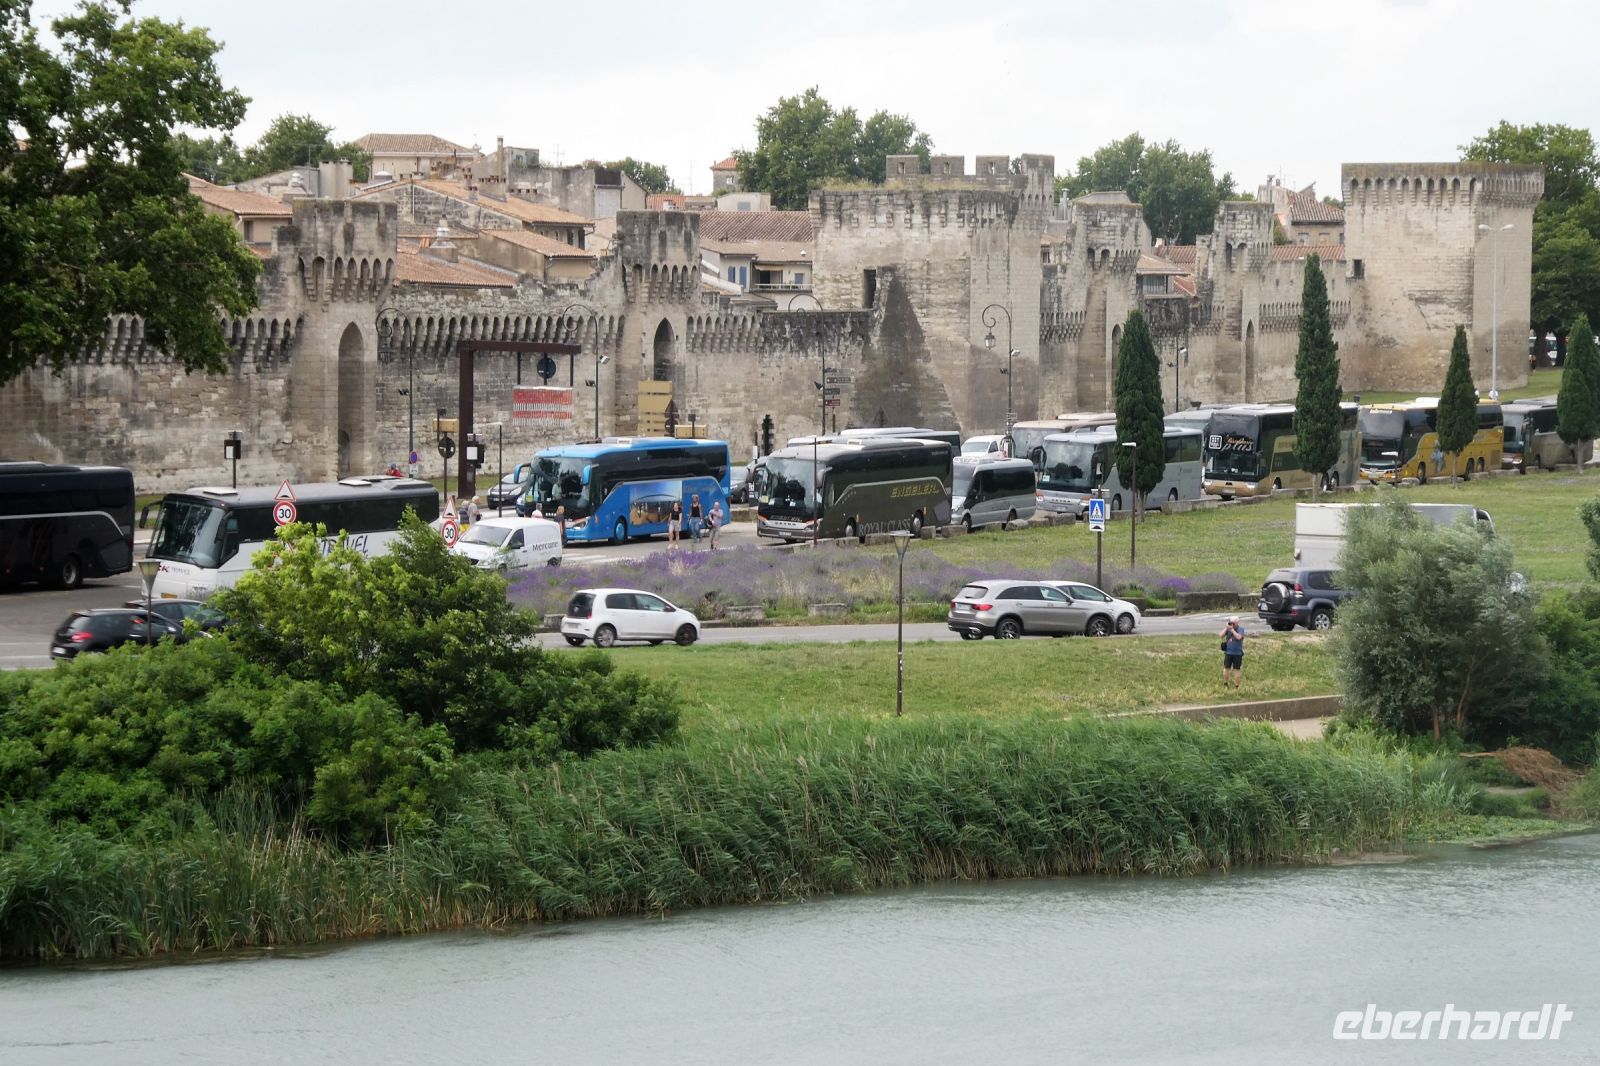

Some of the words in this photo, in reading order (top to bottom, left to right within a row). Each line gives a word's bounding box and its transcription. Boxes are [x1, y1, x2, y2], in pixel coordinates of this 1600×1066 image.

[279, 508, 291, 518] 30
[445, 527, 454, 538] 30
[859, 520, 885, 536] ROYAL
[887, 518, 911, 532] CLASS
